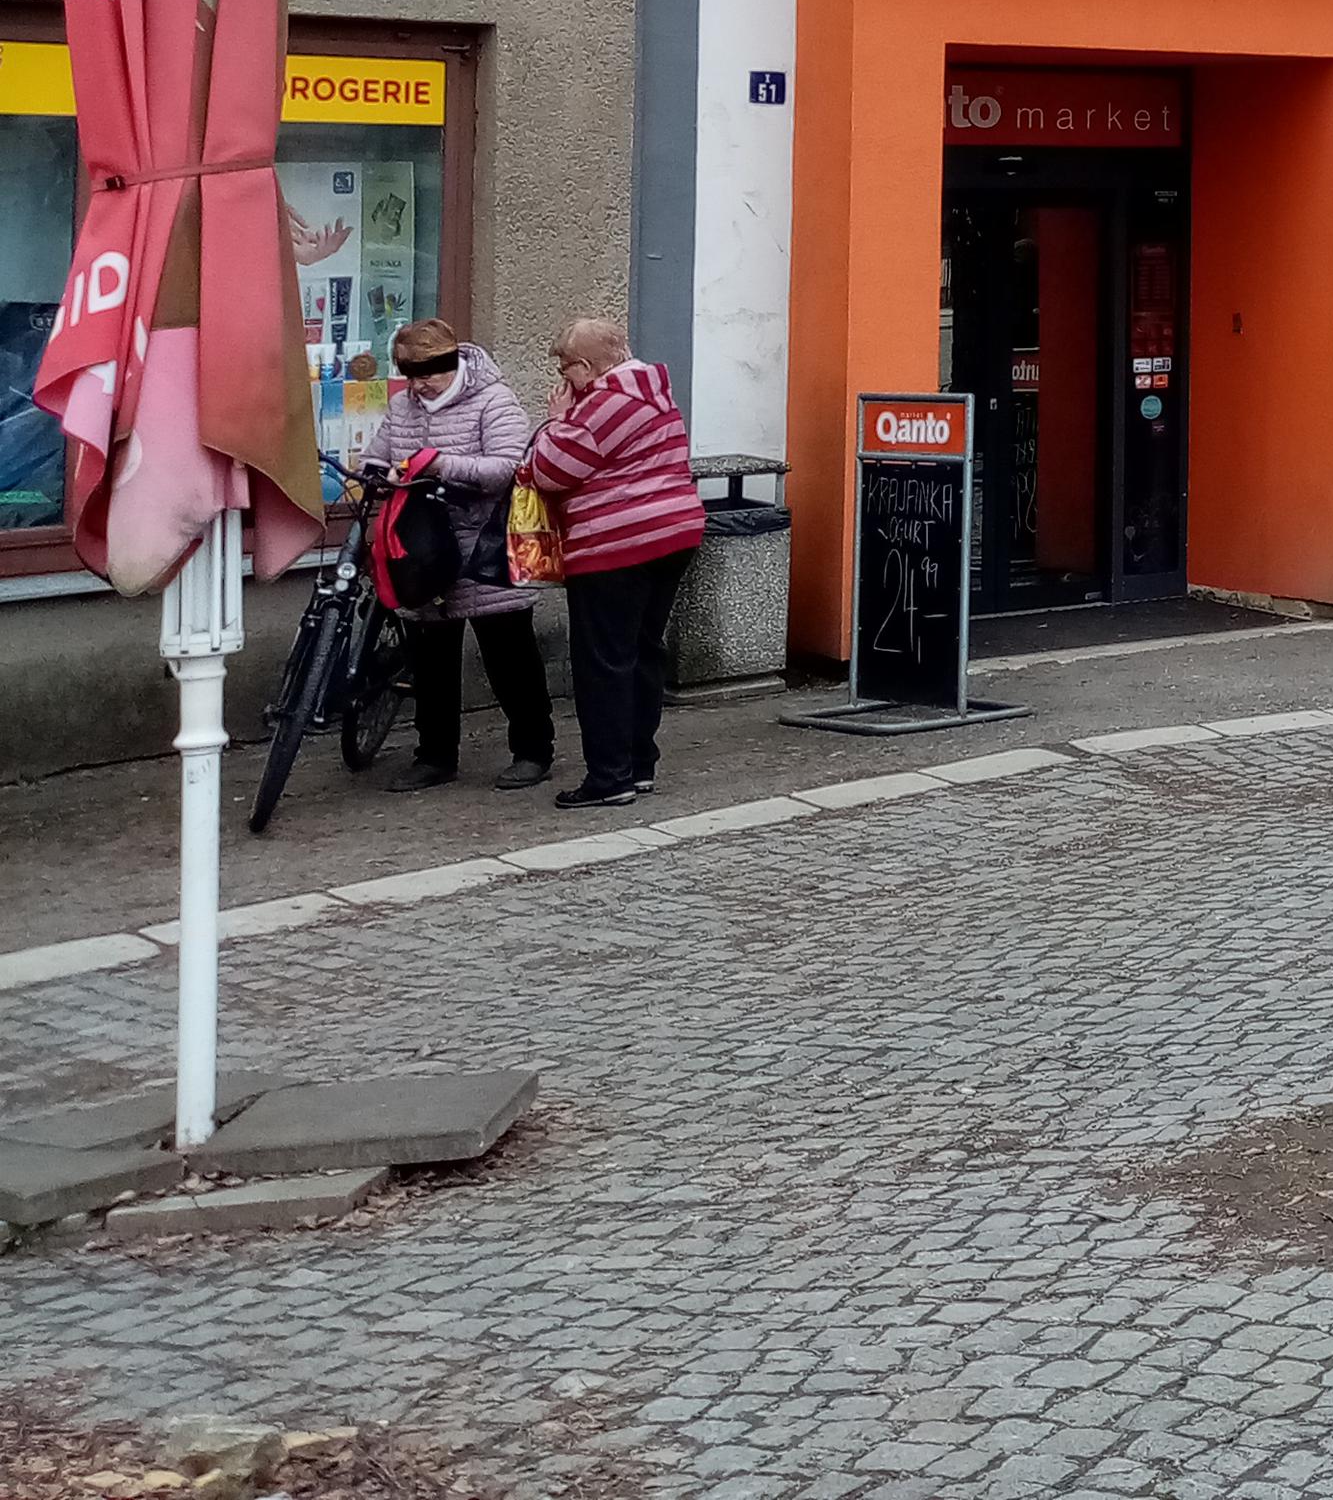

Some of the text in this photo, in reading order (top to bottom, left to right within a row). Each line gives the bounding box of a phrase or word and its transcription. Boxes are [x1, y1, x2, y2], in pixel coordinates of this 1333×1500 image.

[283, 76, 431, 106] ROGERIE
[758, 83, 777, 102] 51
[944, 85, 1171, 131] to market
[876, 410, 950, 445] Qanto
[867, 473, 953, 526] KRAJANKA
